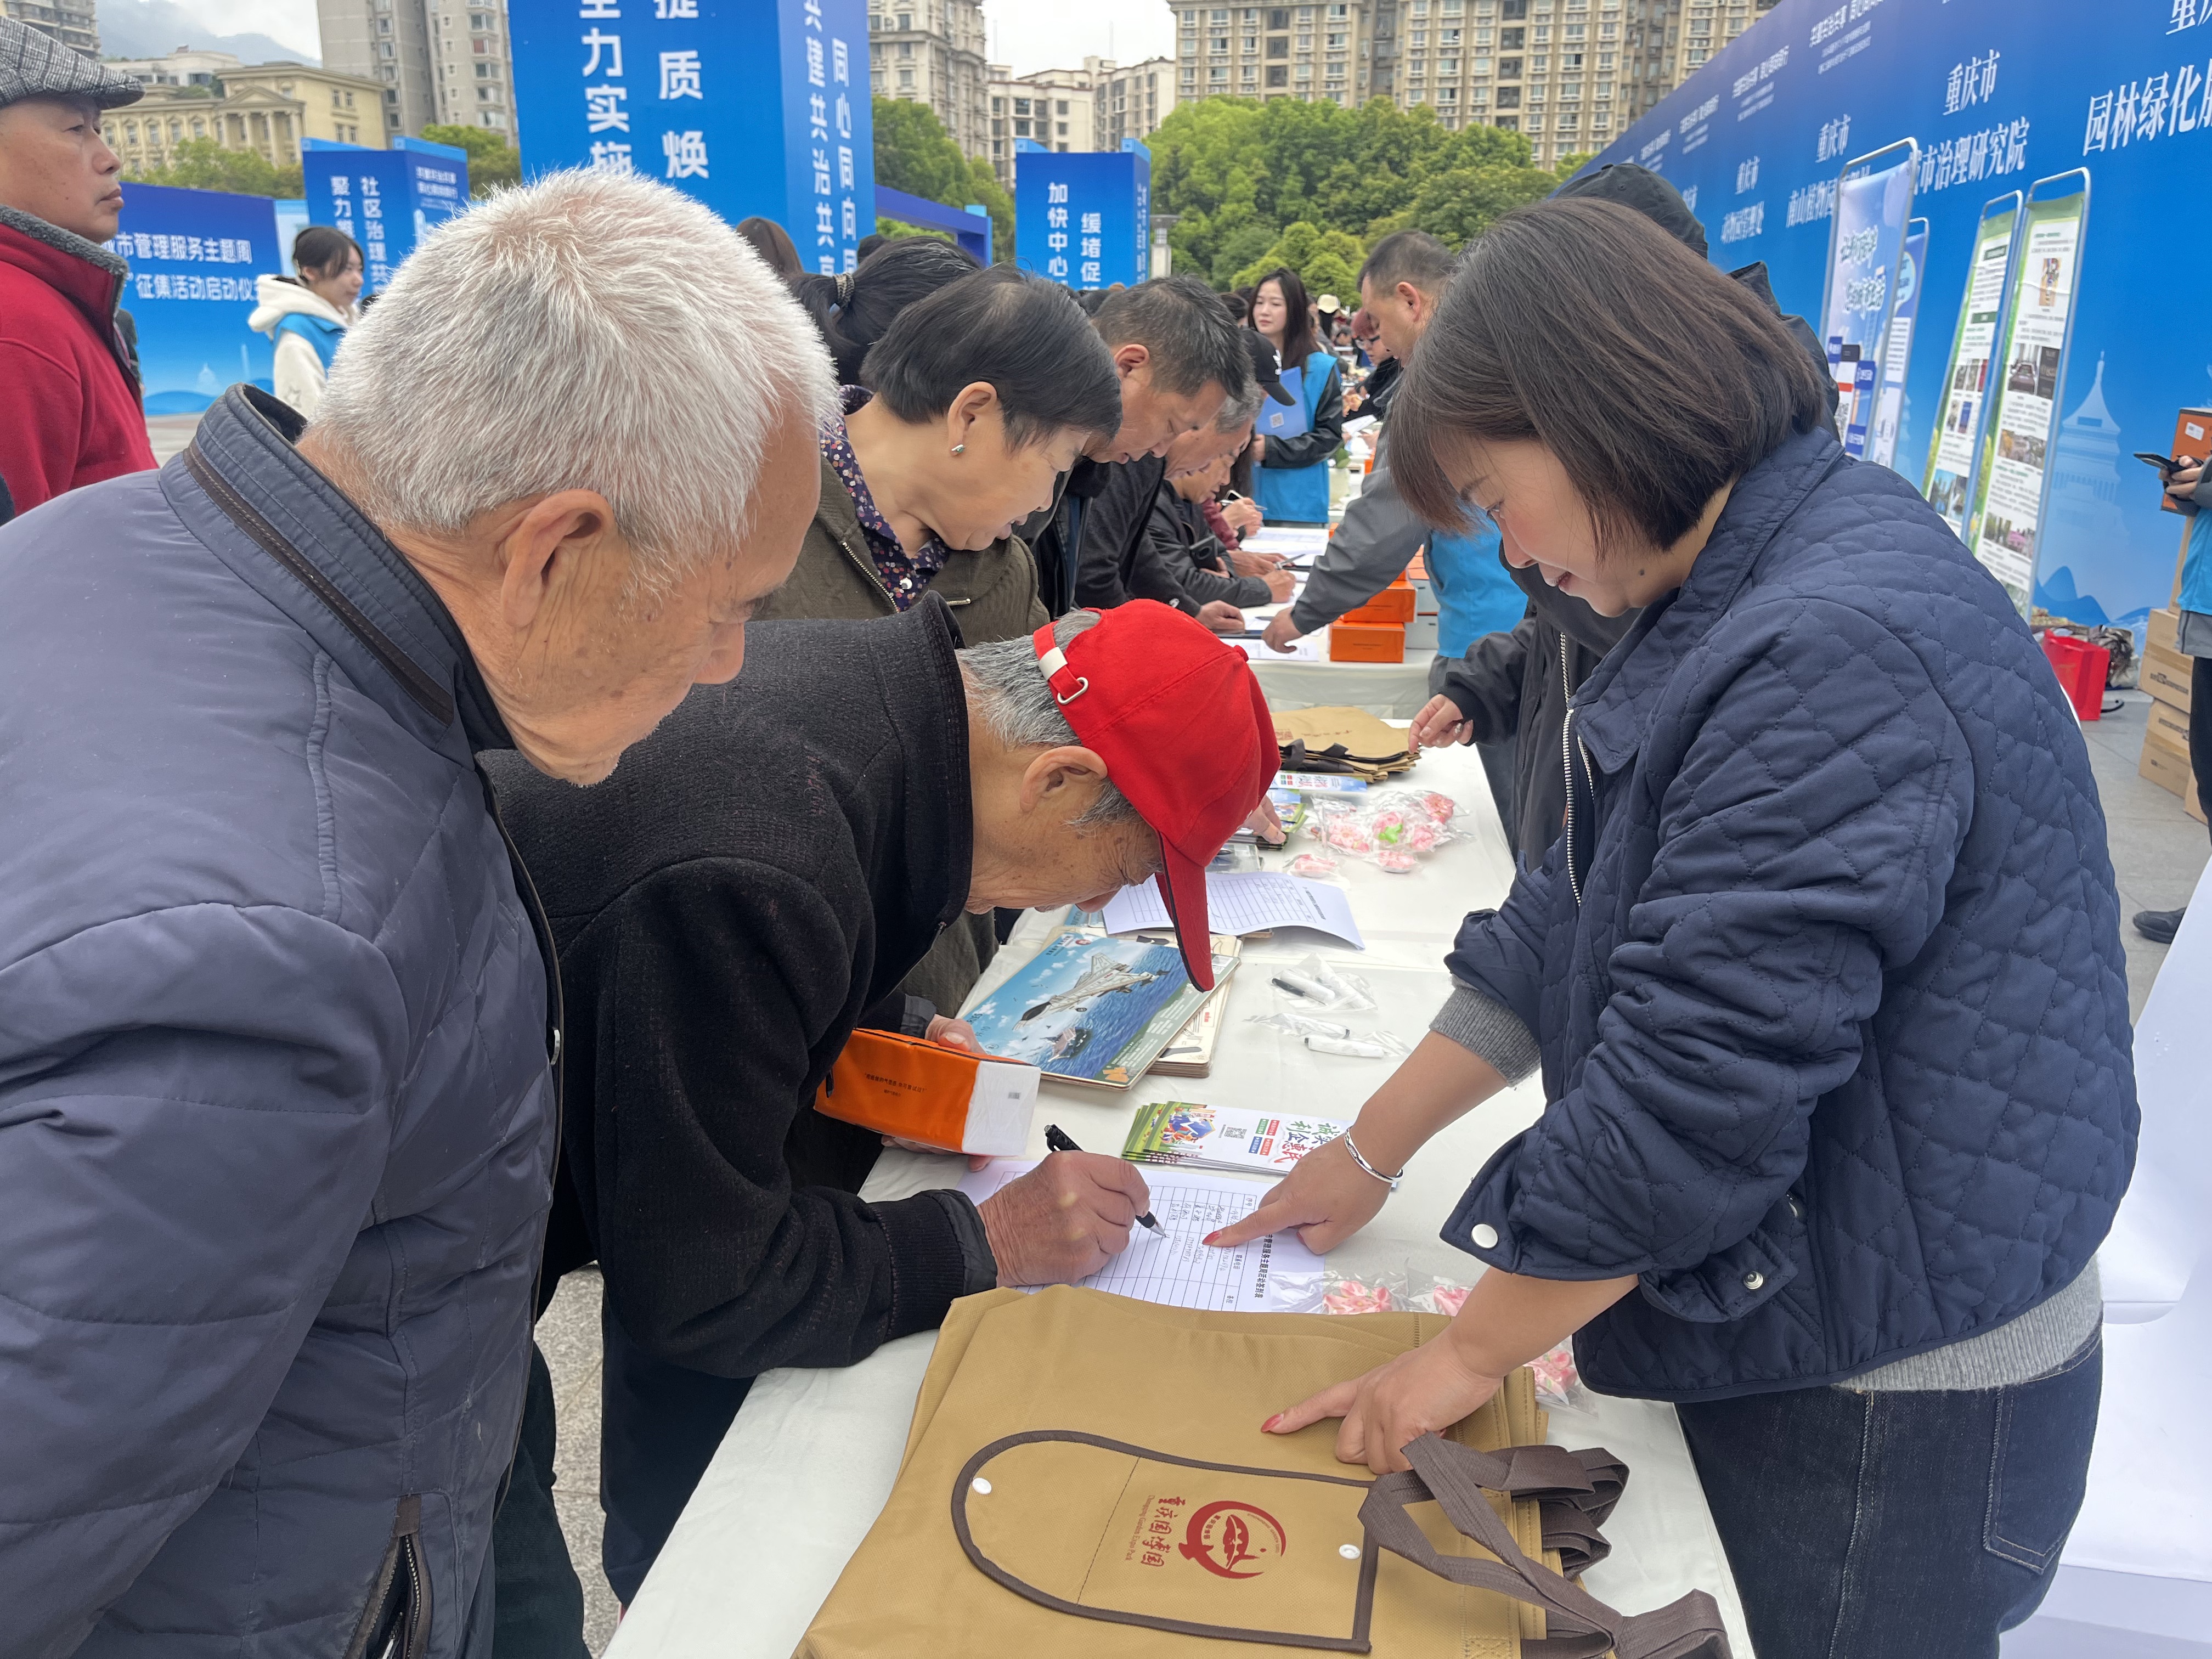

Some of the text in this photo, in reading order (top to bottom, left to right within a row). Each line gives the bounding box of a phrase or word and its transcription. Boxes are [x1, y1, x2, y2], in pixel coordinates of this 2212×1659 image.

[1943, 49, 2000, 116] 重庆市
[360, 176, 387, 294] 社区治理共
[1047, 182, 1068, 285] 加快中心
[1080, 213, 1102, 290] 缓堵促
